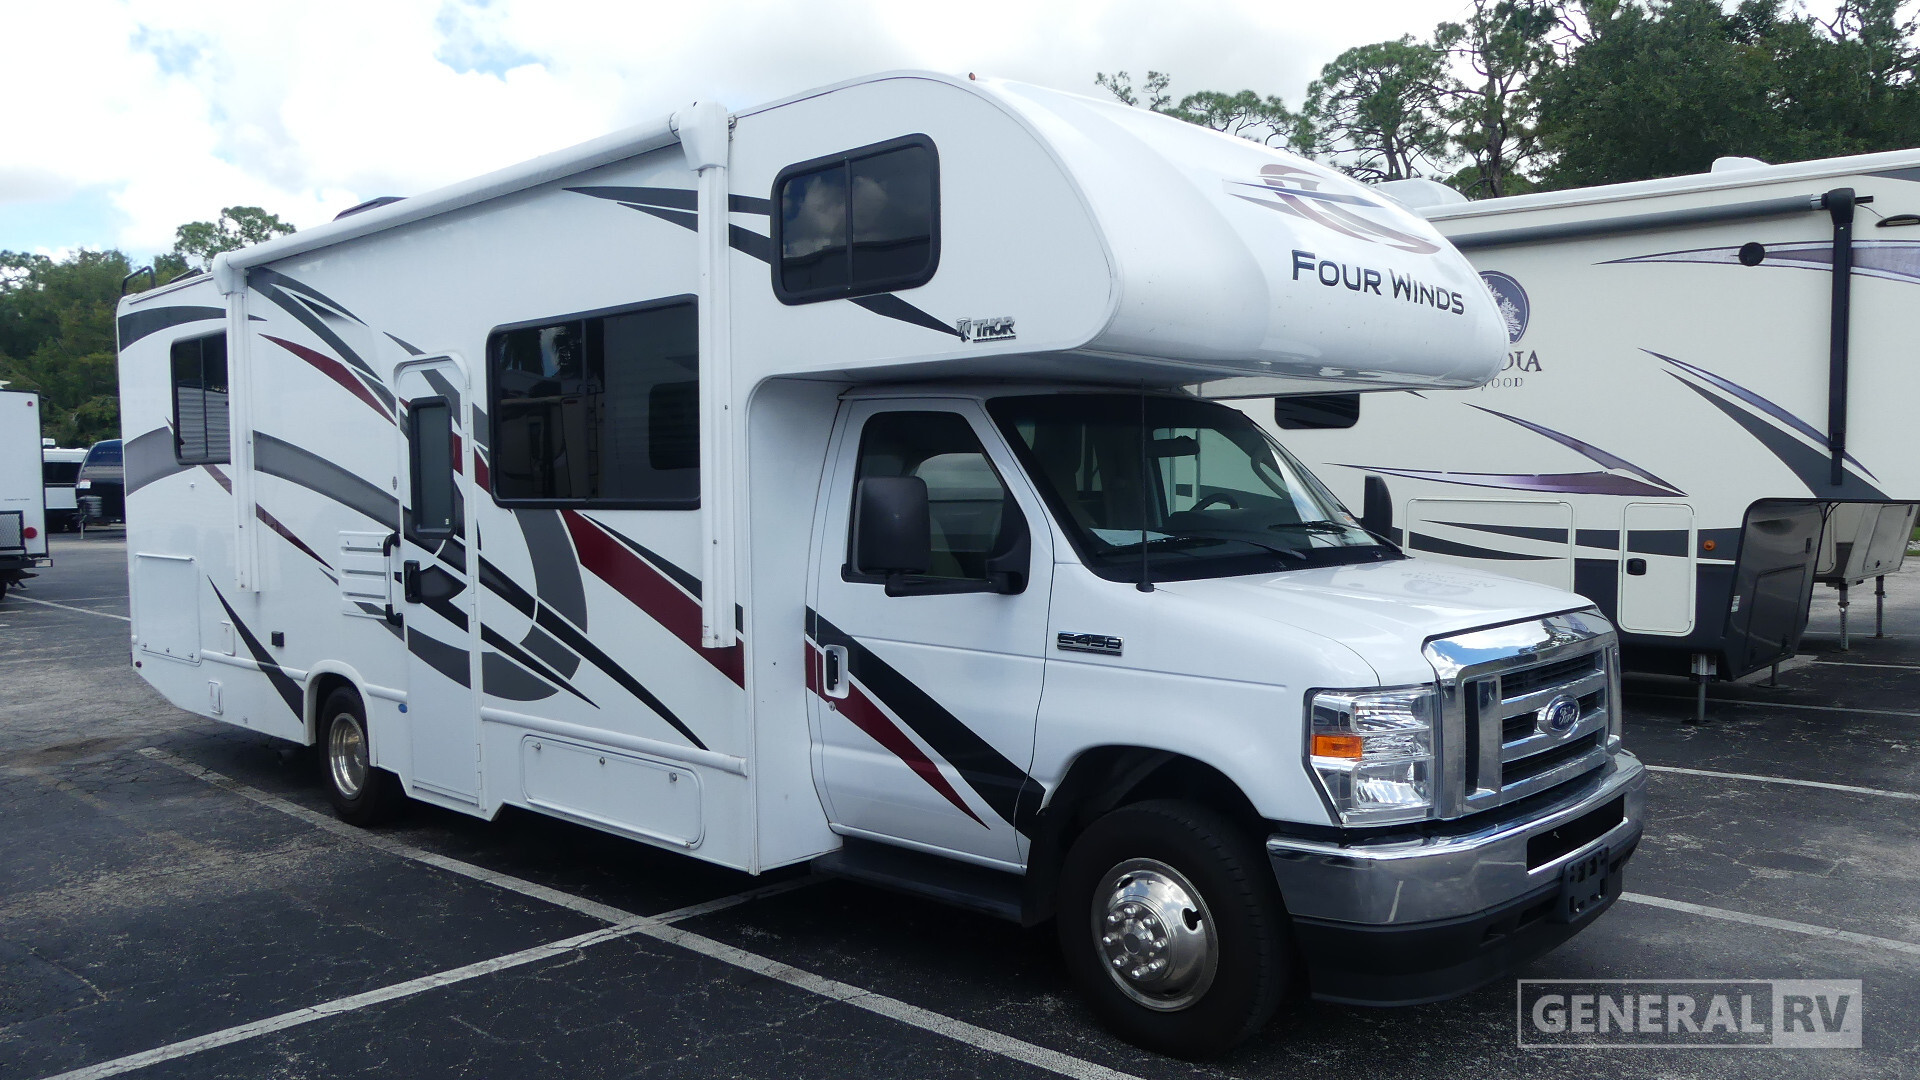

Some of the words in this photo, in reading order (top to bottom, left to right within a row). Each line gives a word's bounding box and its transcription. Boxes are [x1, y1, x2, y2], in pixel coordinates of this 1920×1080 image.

[1291, 249, 1382, 296] FOUR
[1389, 268, 1464, 315] WINDS
[973, 316, 1016, 337] THOR
